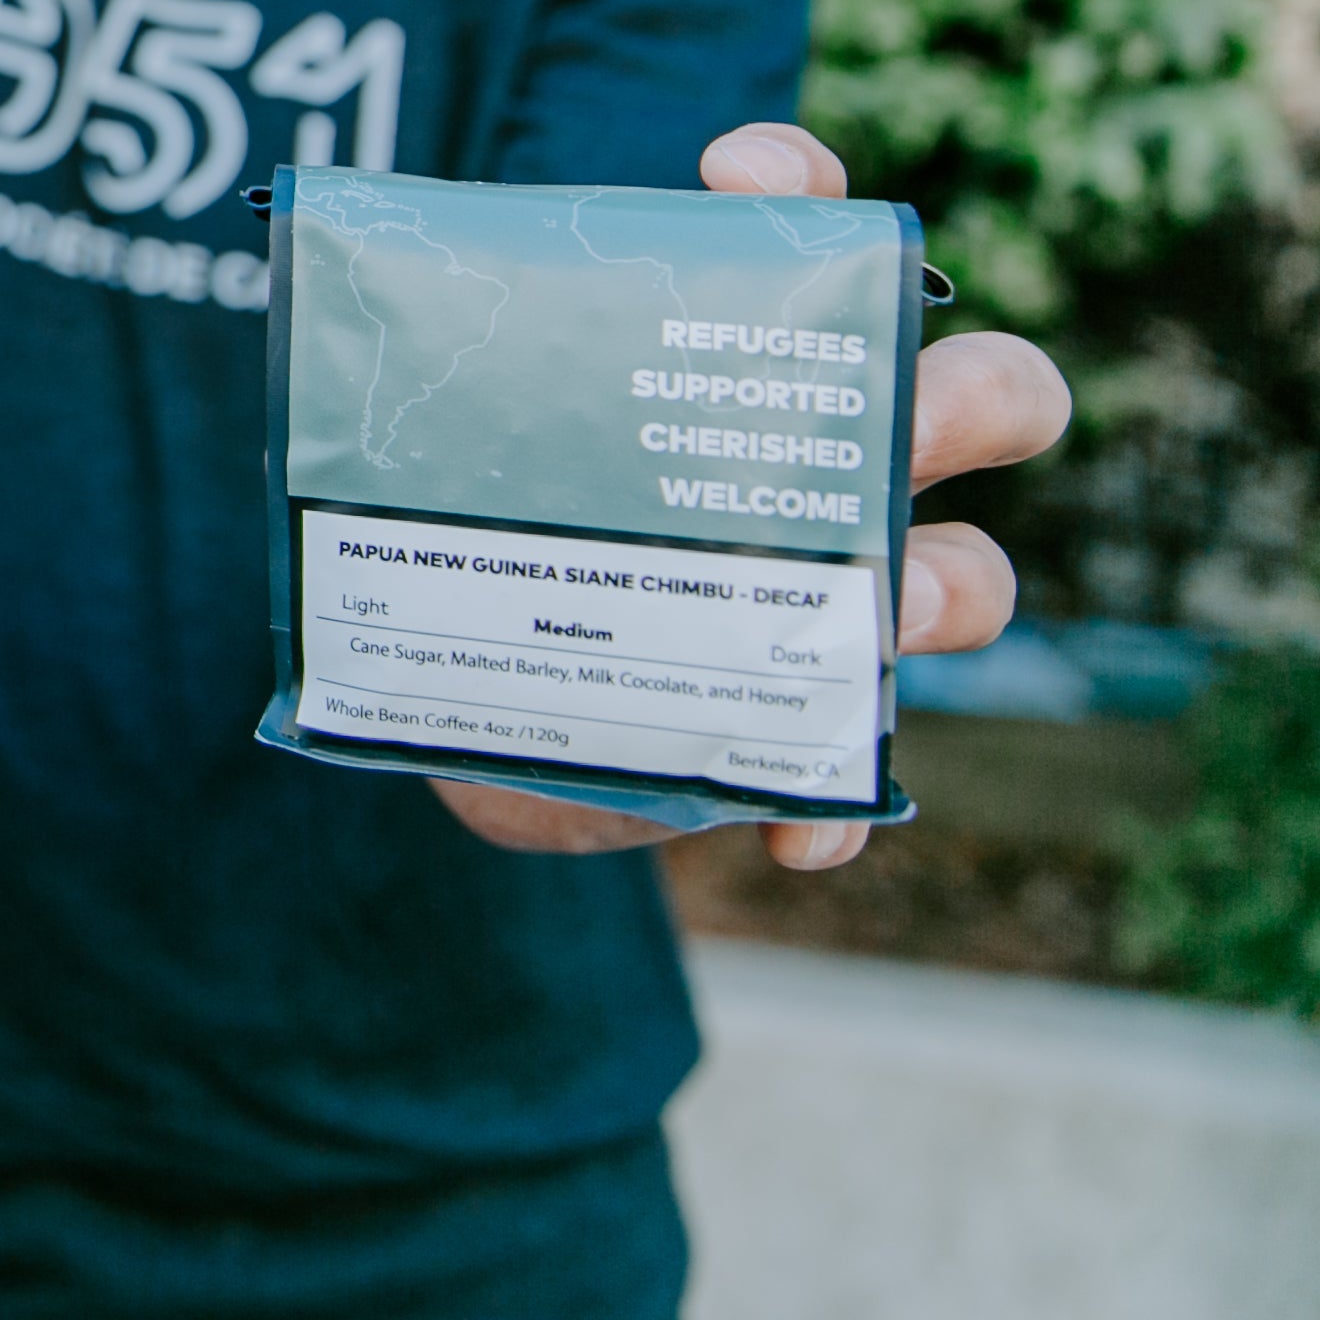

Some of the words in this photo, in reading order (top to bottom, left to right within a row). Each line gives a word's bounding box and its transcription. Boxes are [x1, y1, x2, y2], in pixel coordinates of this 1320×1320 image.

[661, 318, 867, 366] REFUGEES
[631, 368, 866, 417] SUPPORTED
[639, 422, 863, 471] CHERISHED
[660, 476, 861, 525] WELCOME
[339, 541, 408, 565] PAPUA
[413, 550, 467, 571] NEW
[472, 557, 559, 582] GUINEA
[564, 567, 634, 590] SIANE
[640, 576, 734, 601] CHIMBU
[753, 587, 830, 610] DECAF
[342, 593, 390, 616] Light
[534, 618, 613, 642] Medium
[770, 645, 822, 666] Dark
[350, 637, 390, 658] Cane
[394, 644, 445, 667] Sugar,
[450, 651, 510, 673] Malted
[516, 660, 573, 683] Barley,
[578, 667, 616, 686] Milk
[620, 672, 703, 698] Cocolate,
[708, 684, 743, 701] and
[748, 687, 809, 712] Honey
[325, 696, 374, 721] Whole
[378, 707, 419, 726] Bean
[424, 713, 479, 734] Coffee
[483, 721, 514, 737] 4oz
[518, 726, 570, 747] /120g
[728, 751, 809, 779] Berkeley,
[814, 760, 841, 779] CA
